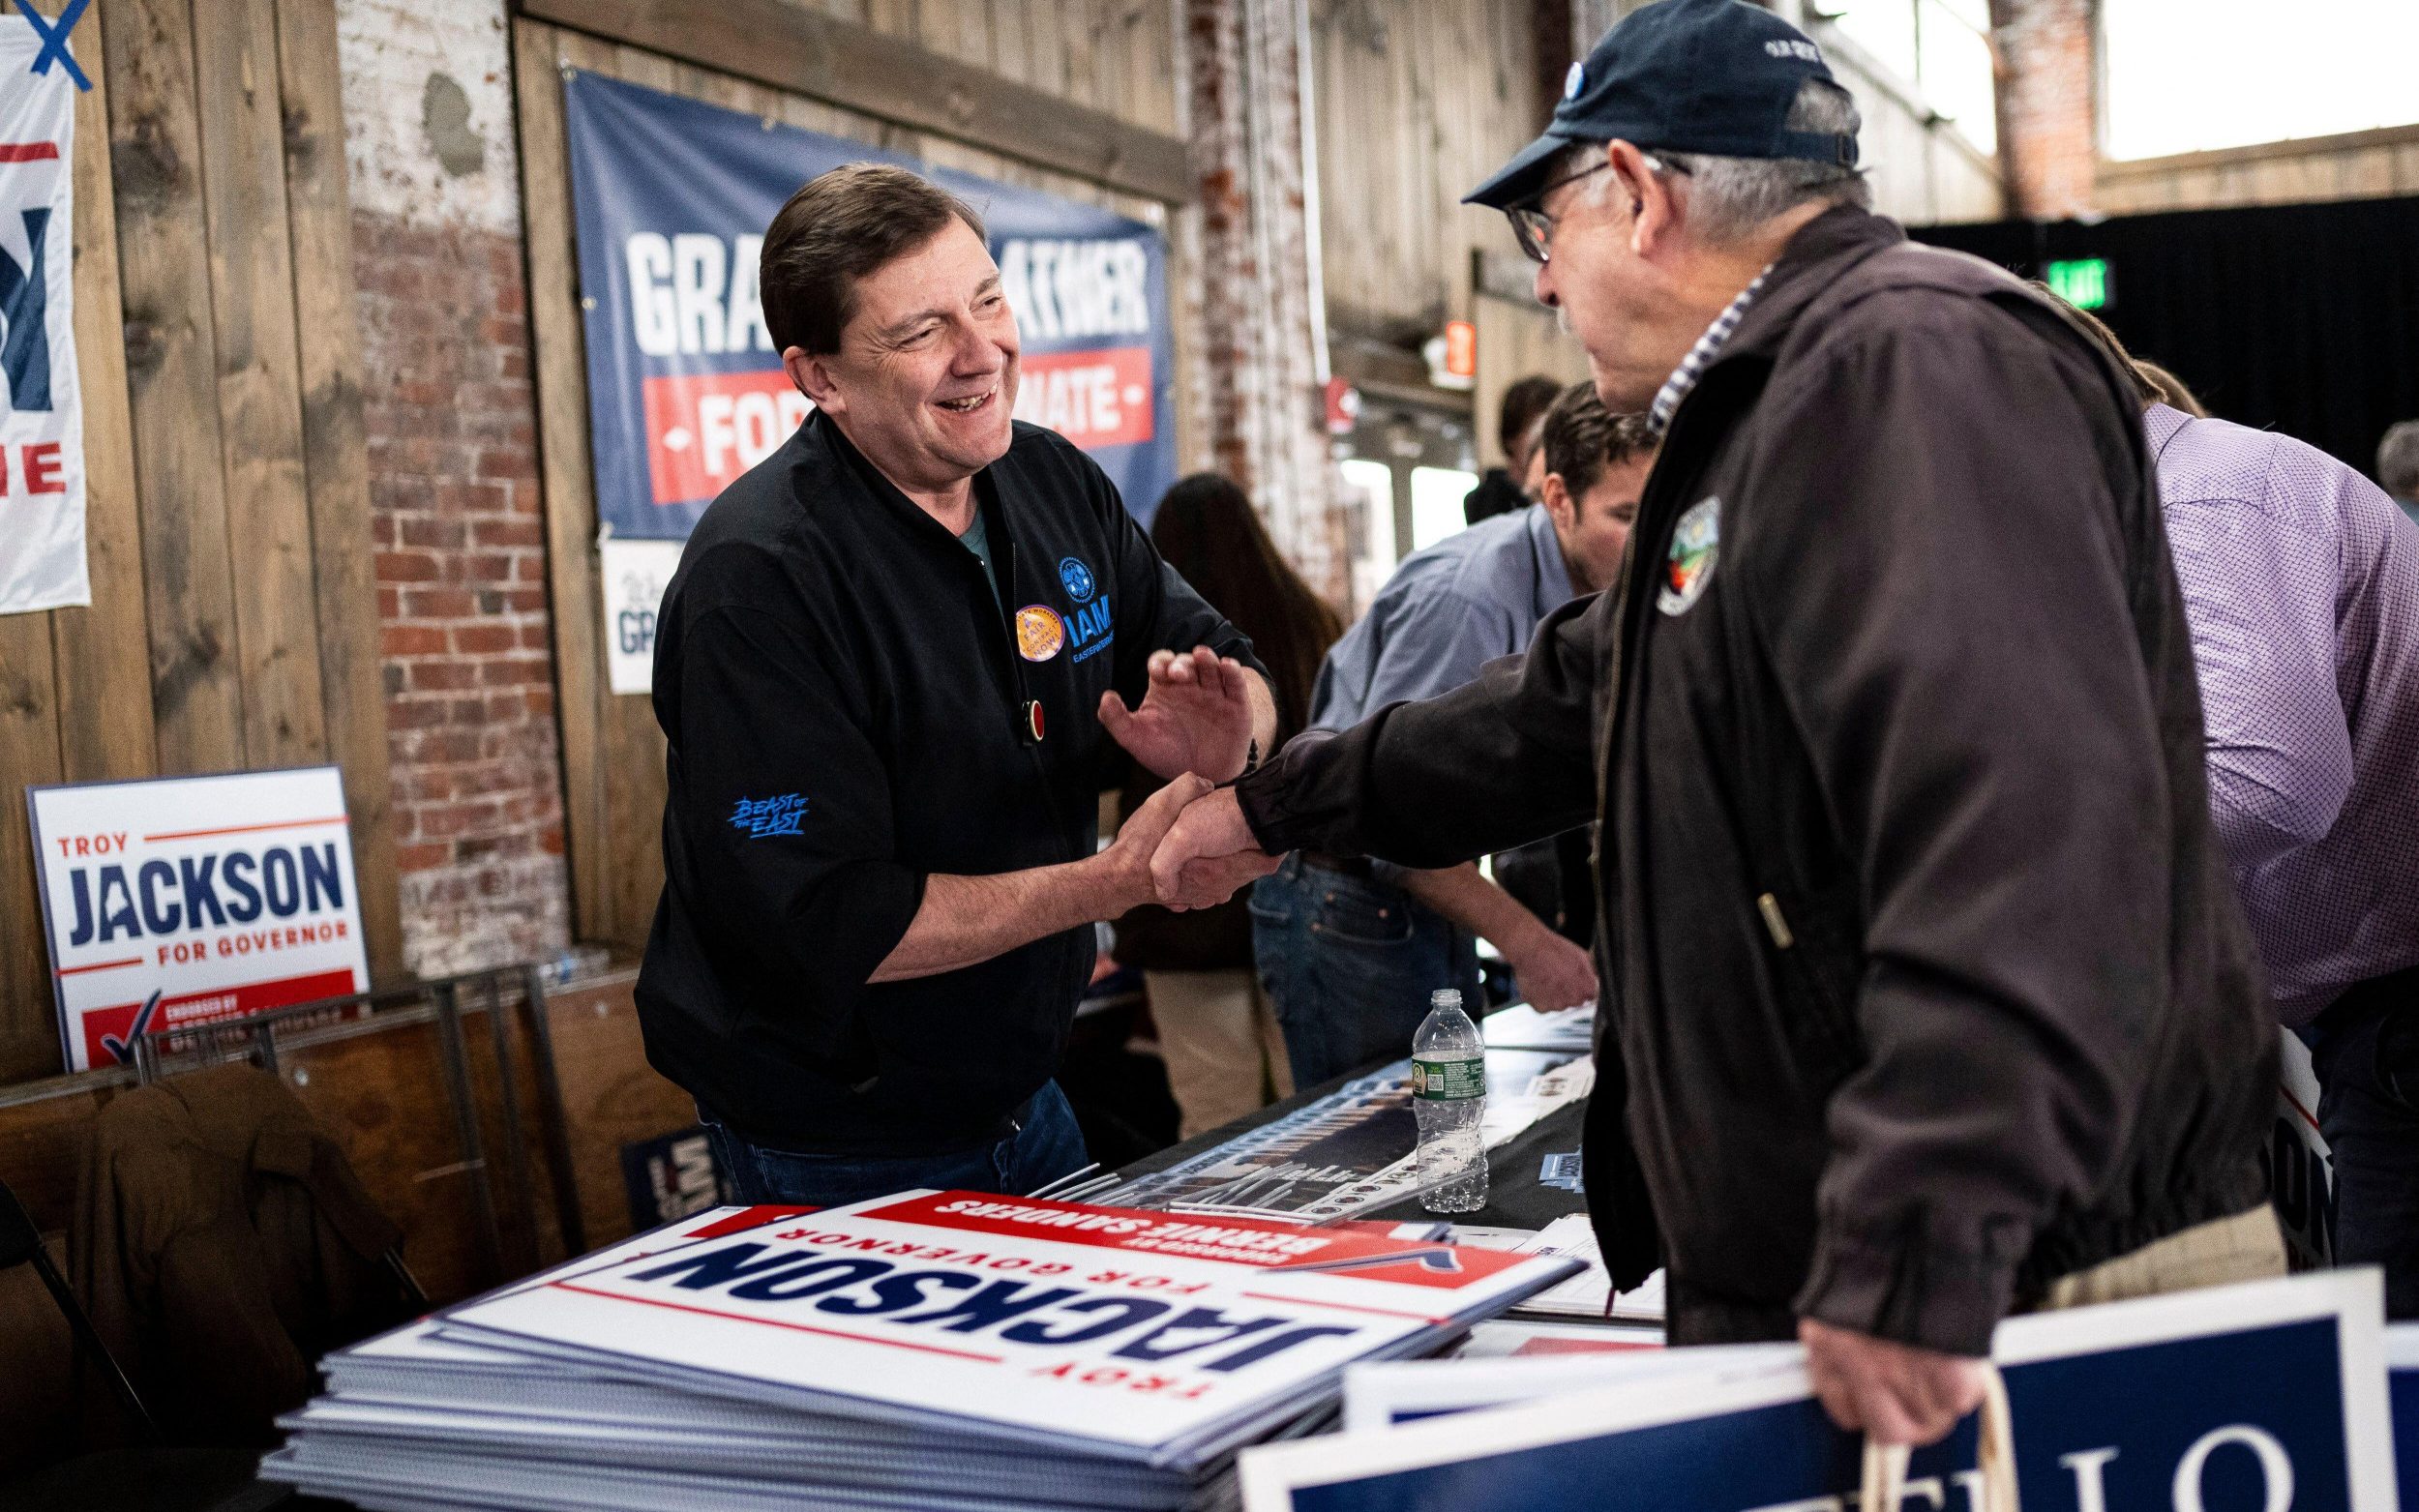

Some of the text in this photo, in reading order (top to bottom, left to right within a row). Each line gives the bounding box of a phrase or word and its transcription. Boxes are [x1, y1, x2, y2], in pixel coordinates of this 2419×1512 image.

[627, 231, 1150, 357] GRA ATNER
[1016, 365, 1123, 431] NATE
[1025, 622, 1046, 641] FAIR
[1027, 625, 1057, 652] CONTRACT
[1063, 594, 1113, 648] IAM
[728, 793, 800, 821] BEAST
[750, 810, 810, 833] EAST
[57, 832, 129, 858] TROY
[70, 843, 344, 947] JACKSON
[157, 923, 349, 965] FOR GOVERNOR
[933, 1200, 1332, 1258] BERNIE SANDERS
[774, 1227, 1212, 1296] FOR GOVERNOR
[1158, 1240, 1293, 1264] ENDORSED
[623, 1241, 1360, 1372] JACKSON
[1030, 1361, 1213, 1401] TROY
